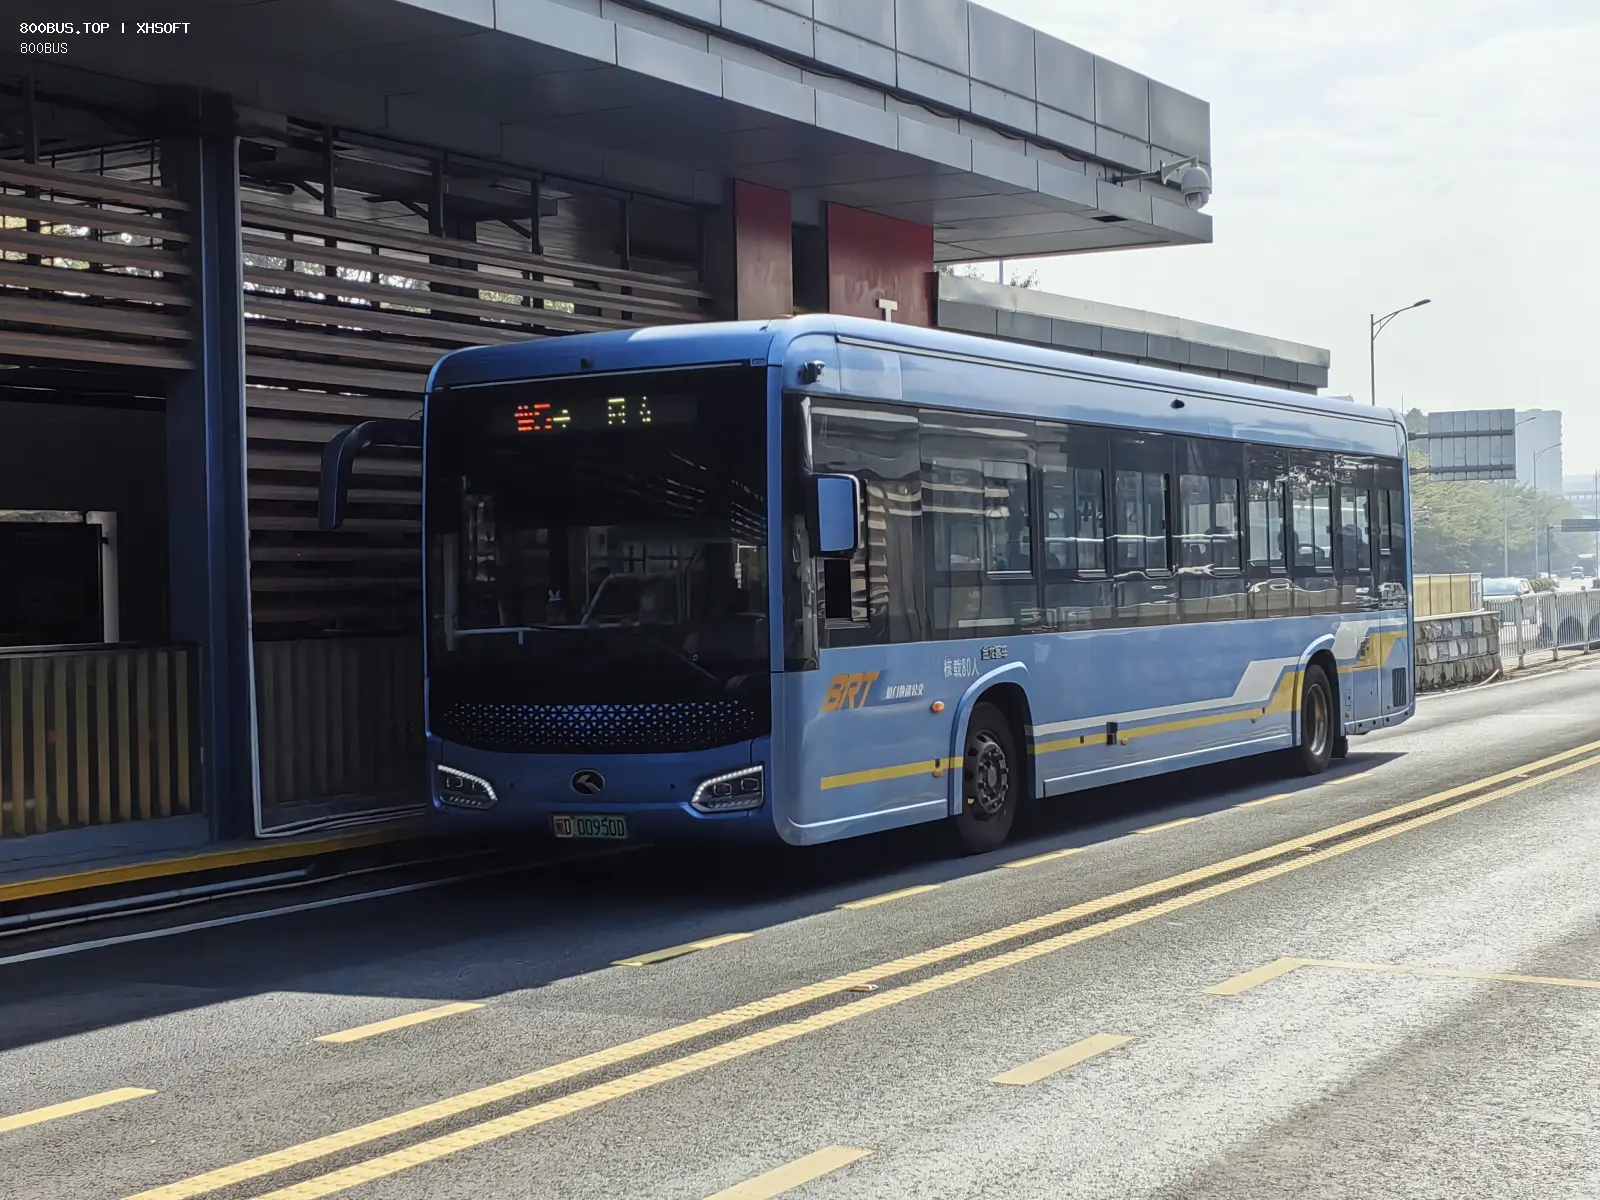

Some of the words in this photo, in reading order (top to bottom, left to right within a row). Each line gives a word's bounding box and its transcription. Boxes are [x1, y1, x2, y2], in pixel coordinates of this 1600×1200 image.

[943, 656, 980, 678] 核载80人
[822, 671, 881, 712] BRT
